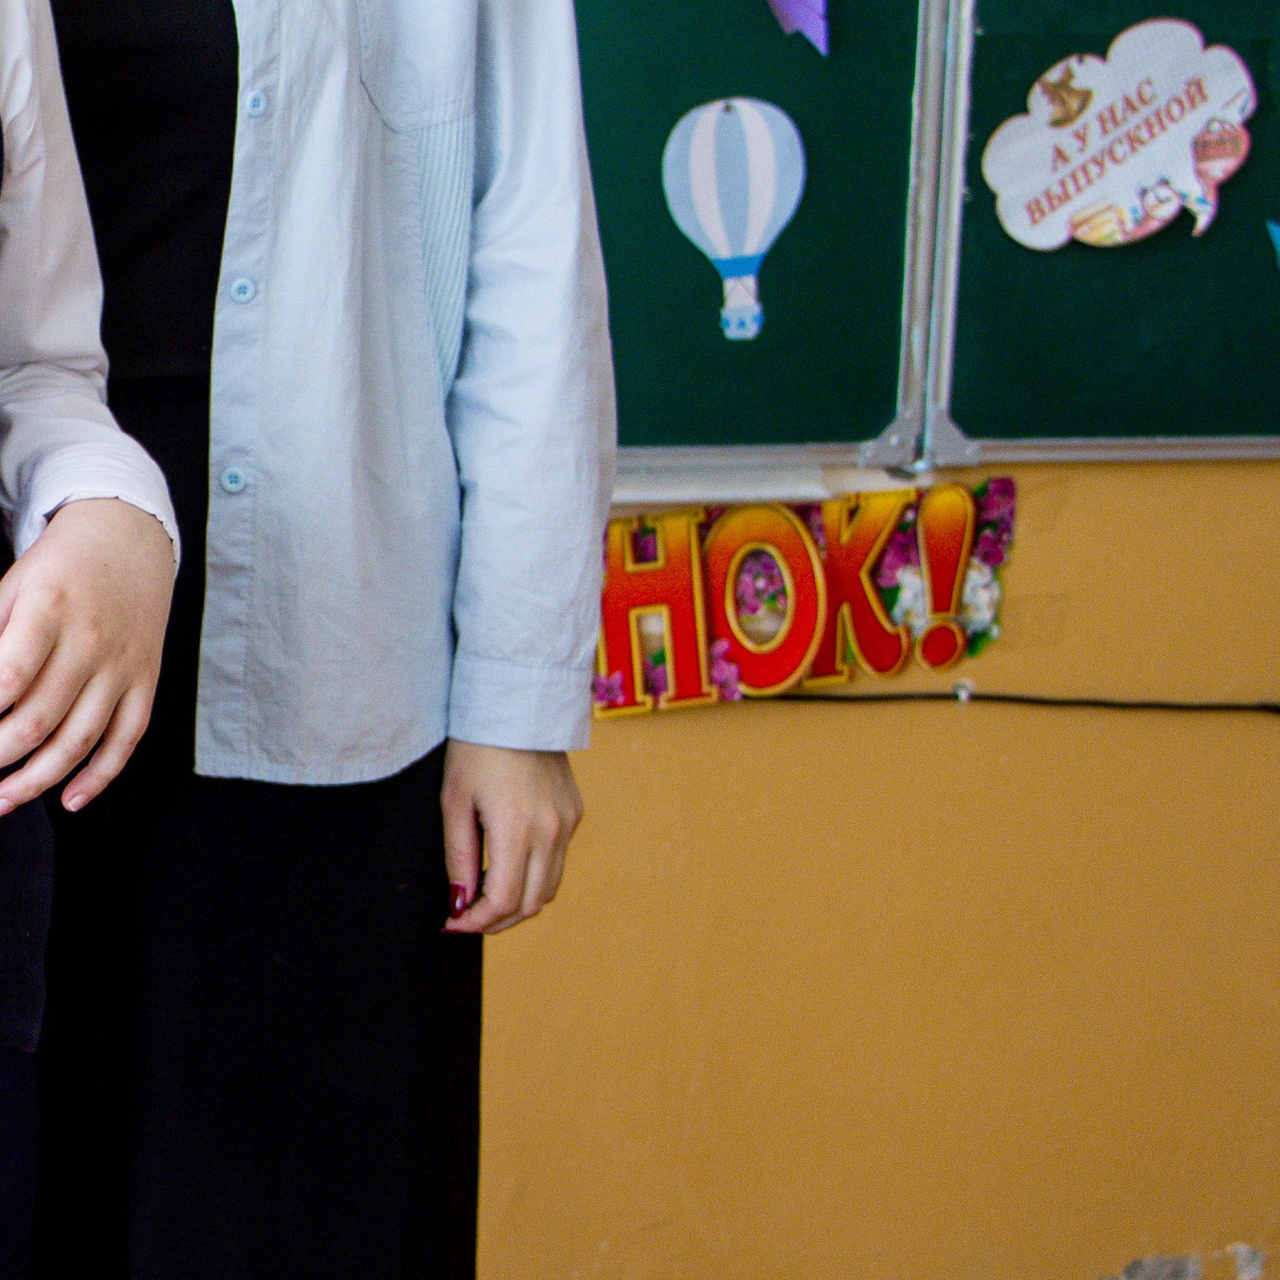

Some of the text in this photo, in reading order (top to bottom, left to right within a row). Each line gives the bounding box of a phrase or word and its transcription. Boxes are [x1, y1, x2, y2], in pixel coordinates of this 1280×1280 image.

[1025, 77, 1210, 227] ВЫПУСКНОЙ
[1050, 77, 1160, 173] А У НАС
